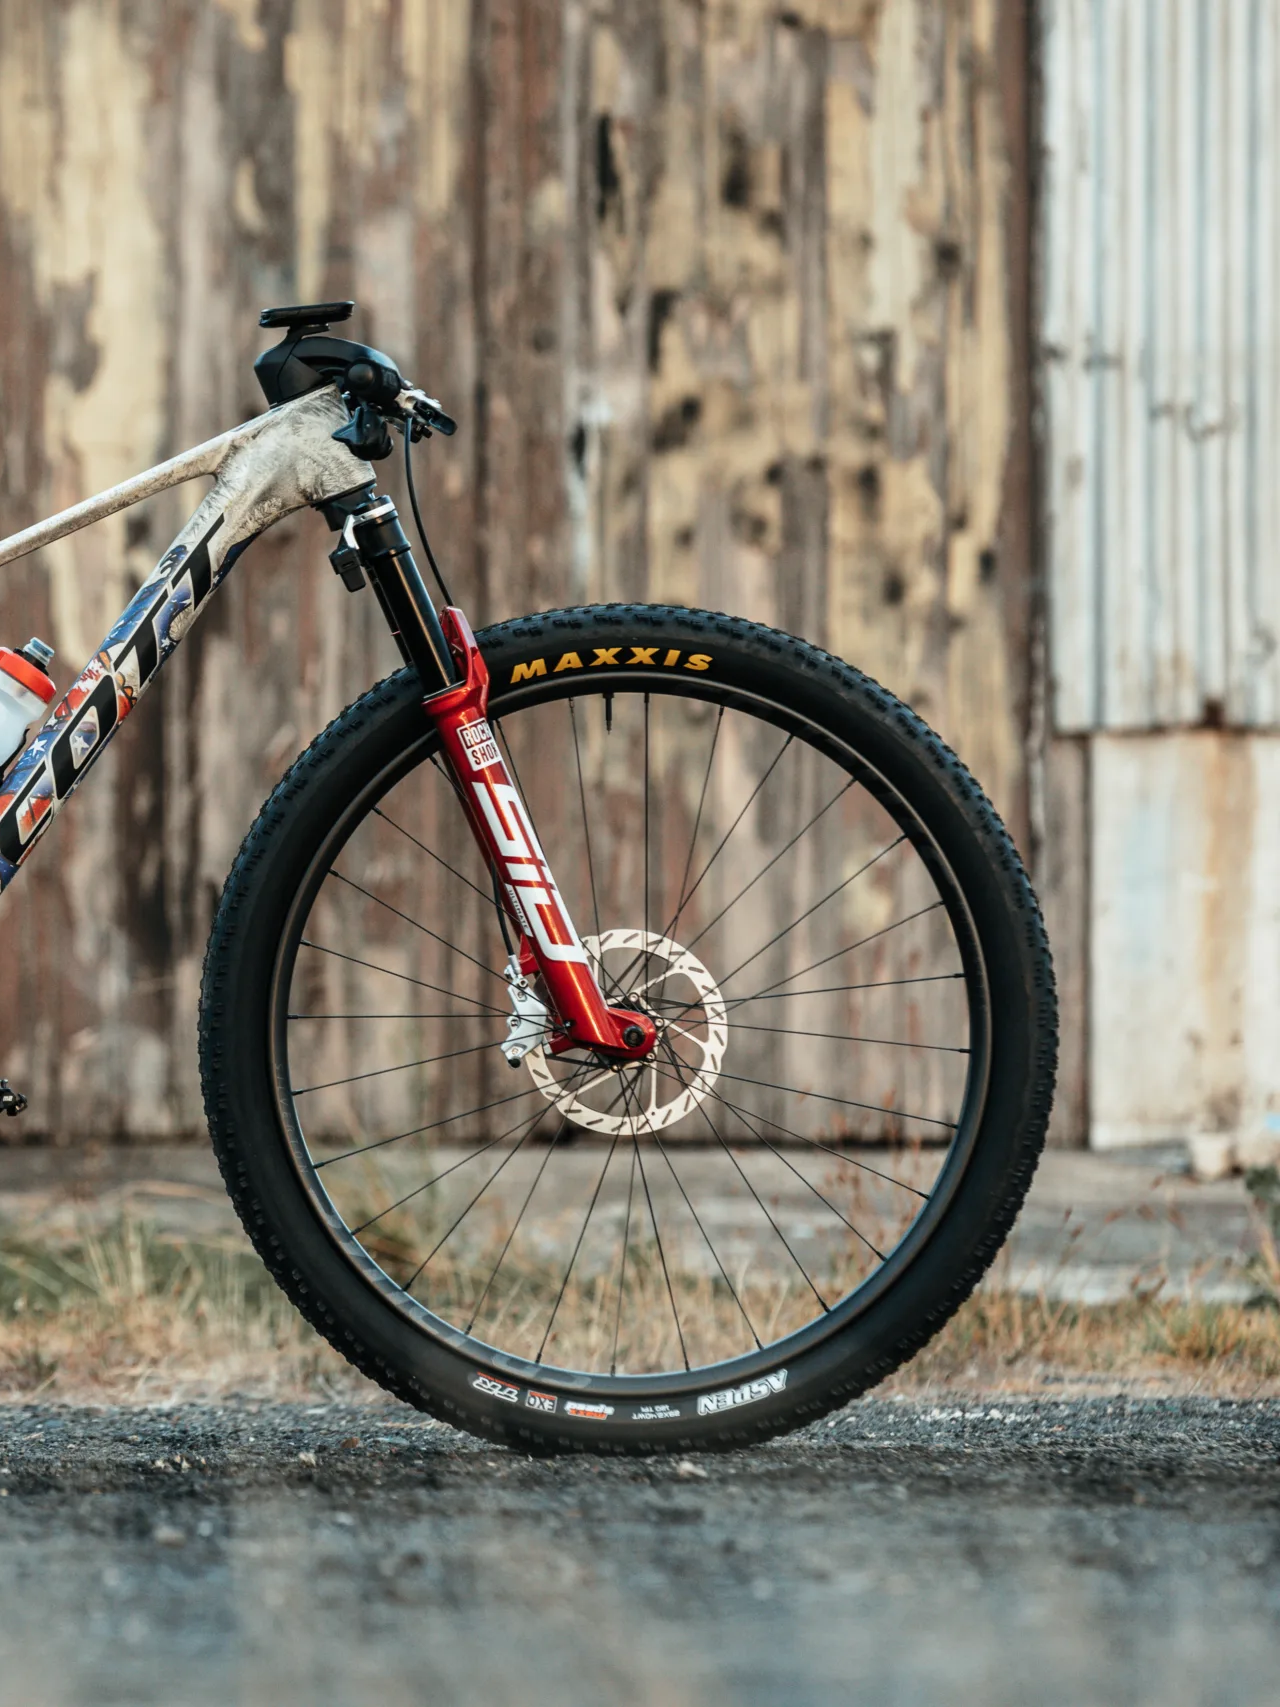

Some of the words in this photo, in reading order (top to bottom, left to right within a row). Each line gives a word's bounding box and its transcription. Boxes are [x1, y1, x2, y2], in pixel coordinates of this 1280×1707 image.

[509, 646, 714, 684] MAXXIS
[508, 889, 529, 930] ULTIMATE
[527, 1395, 556, 1411] EXO
[697, 1368, 789, 1416] ASPEN
